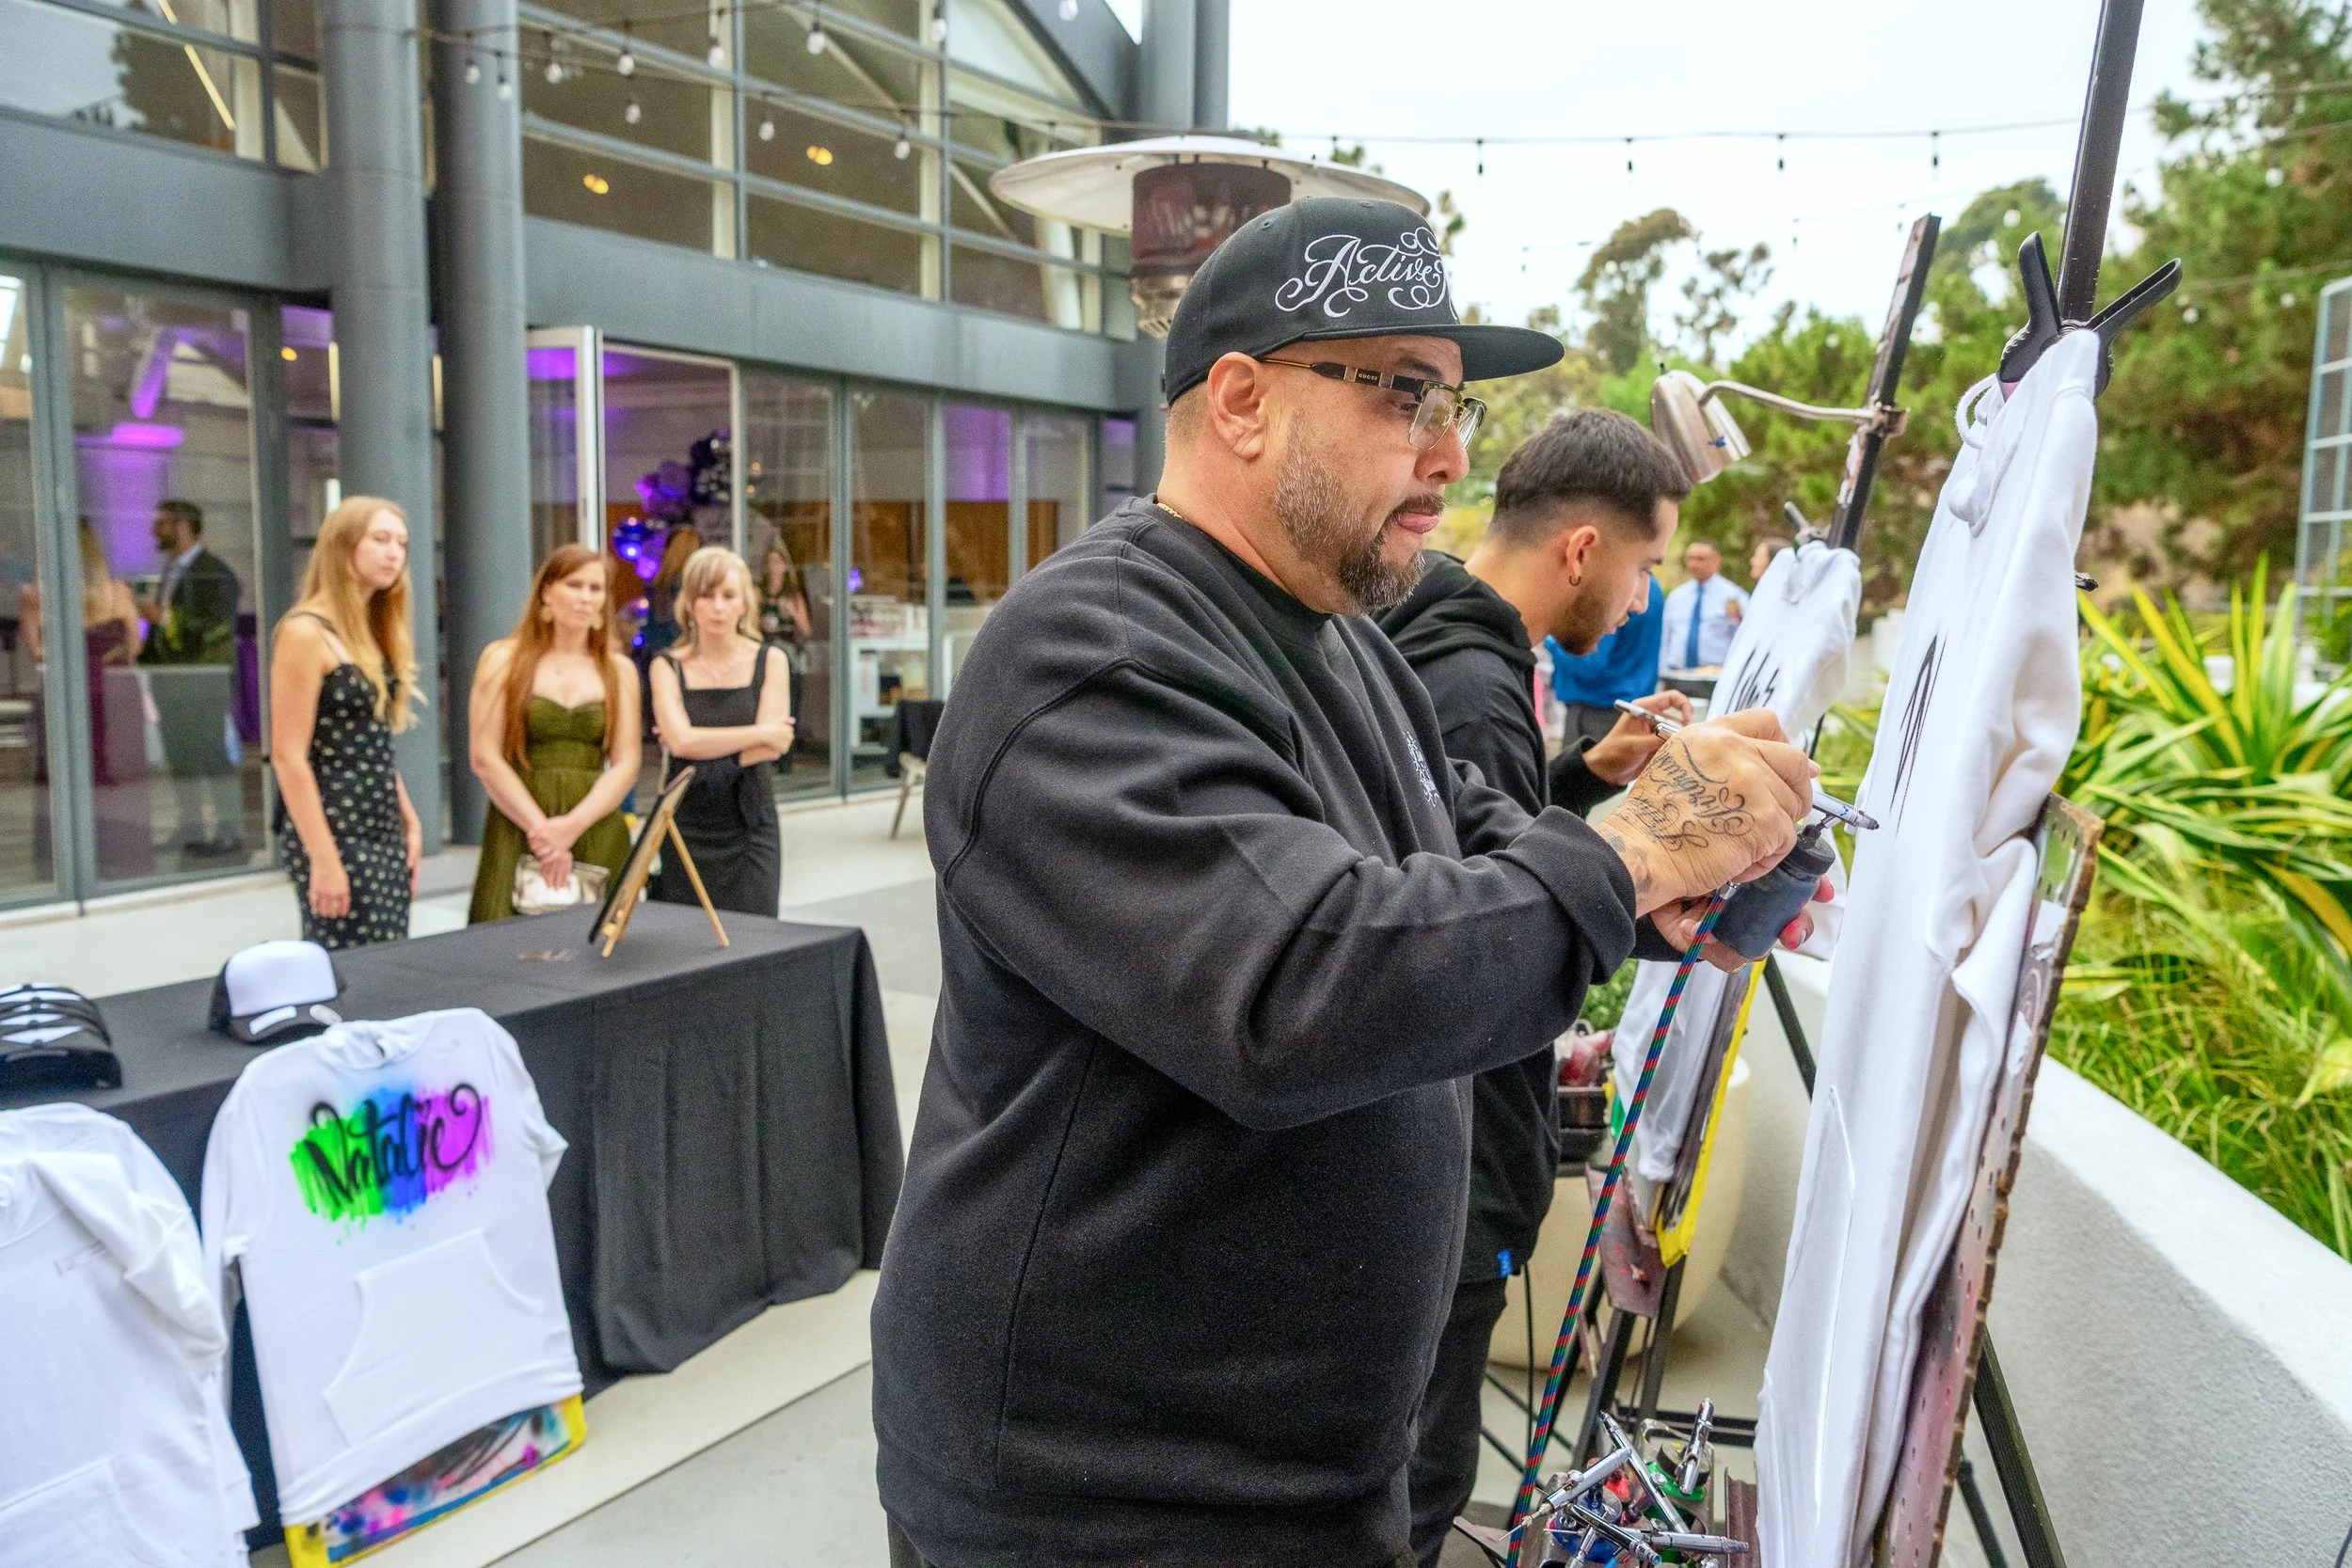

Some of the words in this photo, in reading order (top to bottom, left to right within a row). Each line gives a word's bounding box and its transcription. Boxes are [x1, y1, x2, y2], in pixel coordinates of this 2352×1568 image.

[1275, 227, 1446, 317] Active
[1358, 372, 1378, 381] GUCCI
[303, 1083, 483, 1208] Natalie
